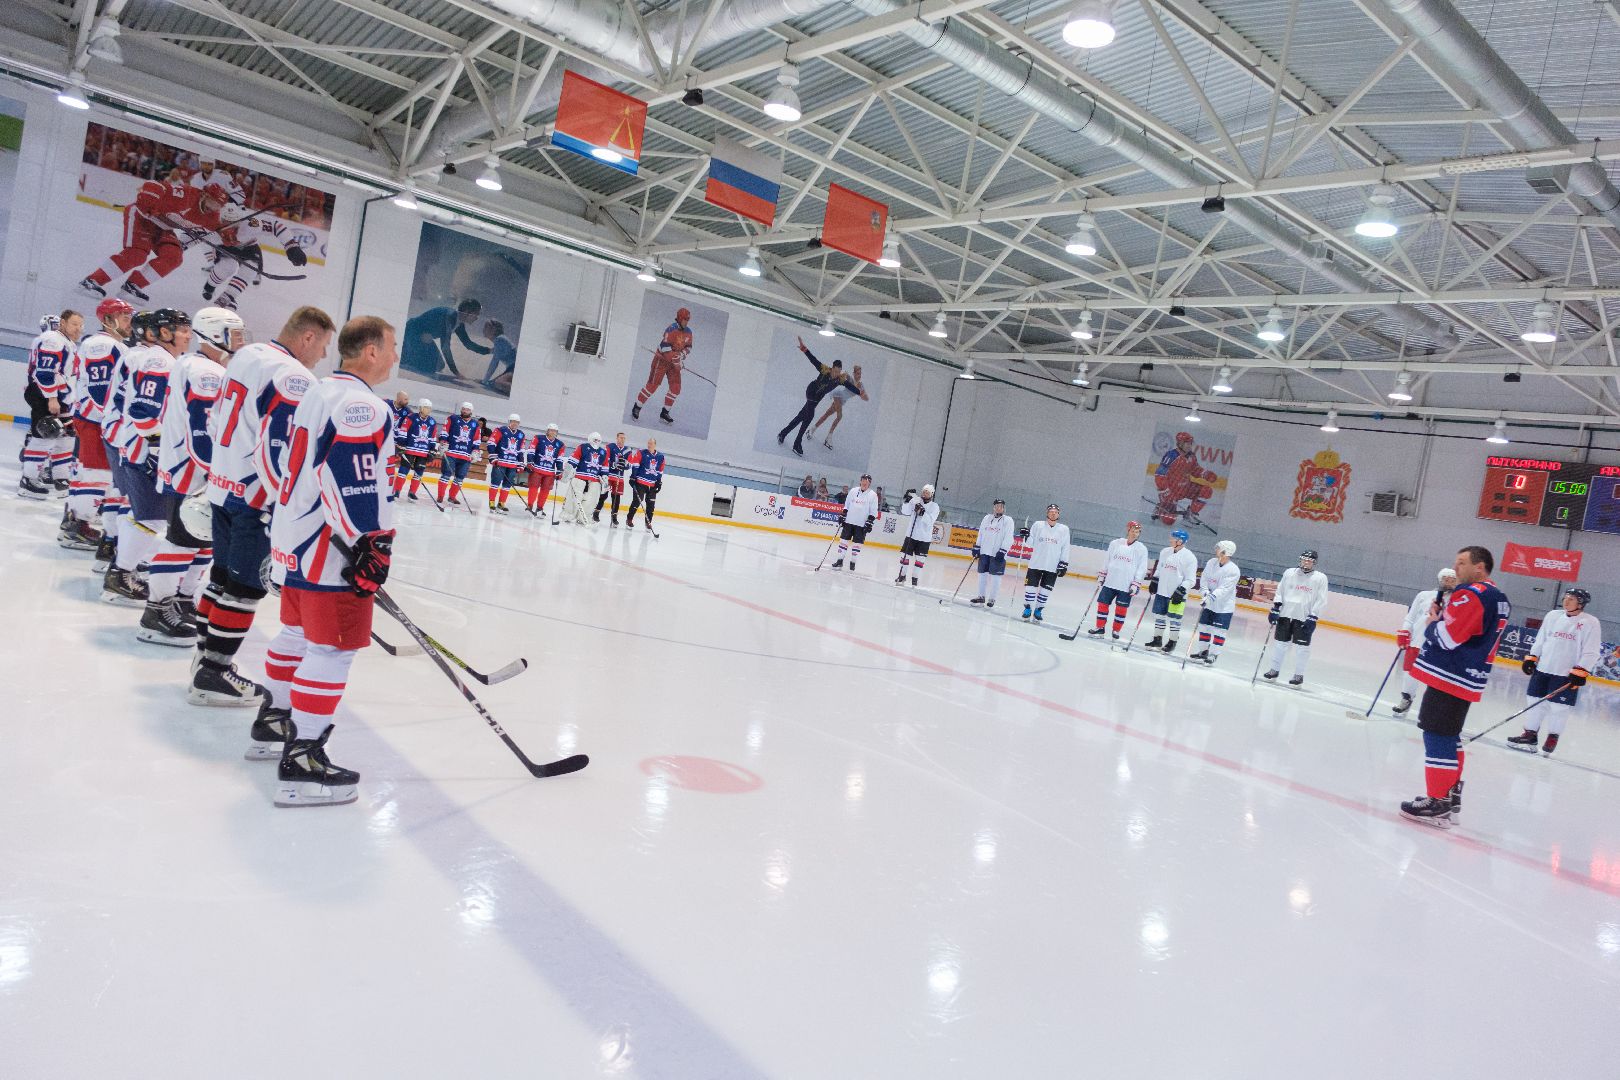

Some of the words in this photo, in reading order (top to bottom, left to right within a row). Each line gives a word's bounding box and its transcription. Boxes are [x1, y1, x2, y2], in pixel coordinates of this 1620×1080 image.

[41, 356, 54, 367] 77
[90, 365, 108, 379] 37
[140, 379, 158, 398] 18
[220, 378, 248, 447] 7
[345, 406, 371, 415] NORTH
[345, 415, 371, 424] HOUSE
[352, 453, 376, 481] 19
[1514, 474, 1527, 489] 0
